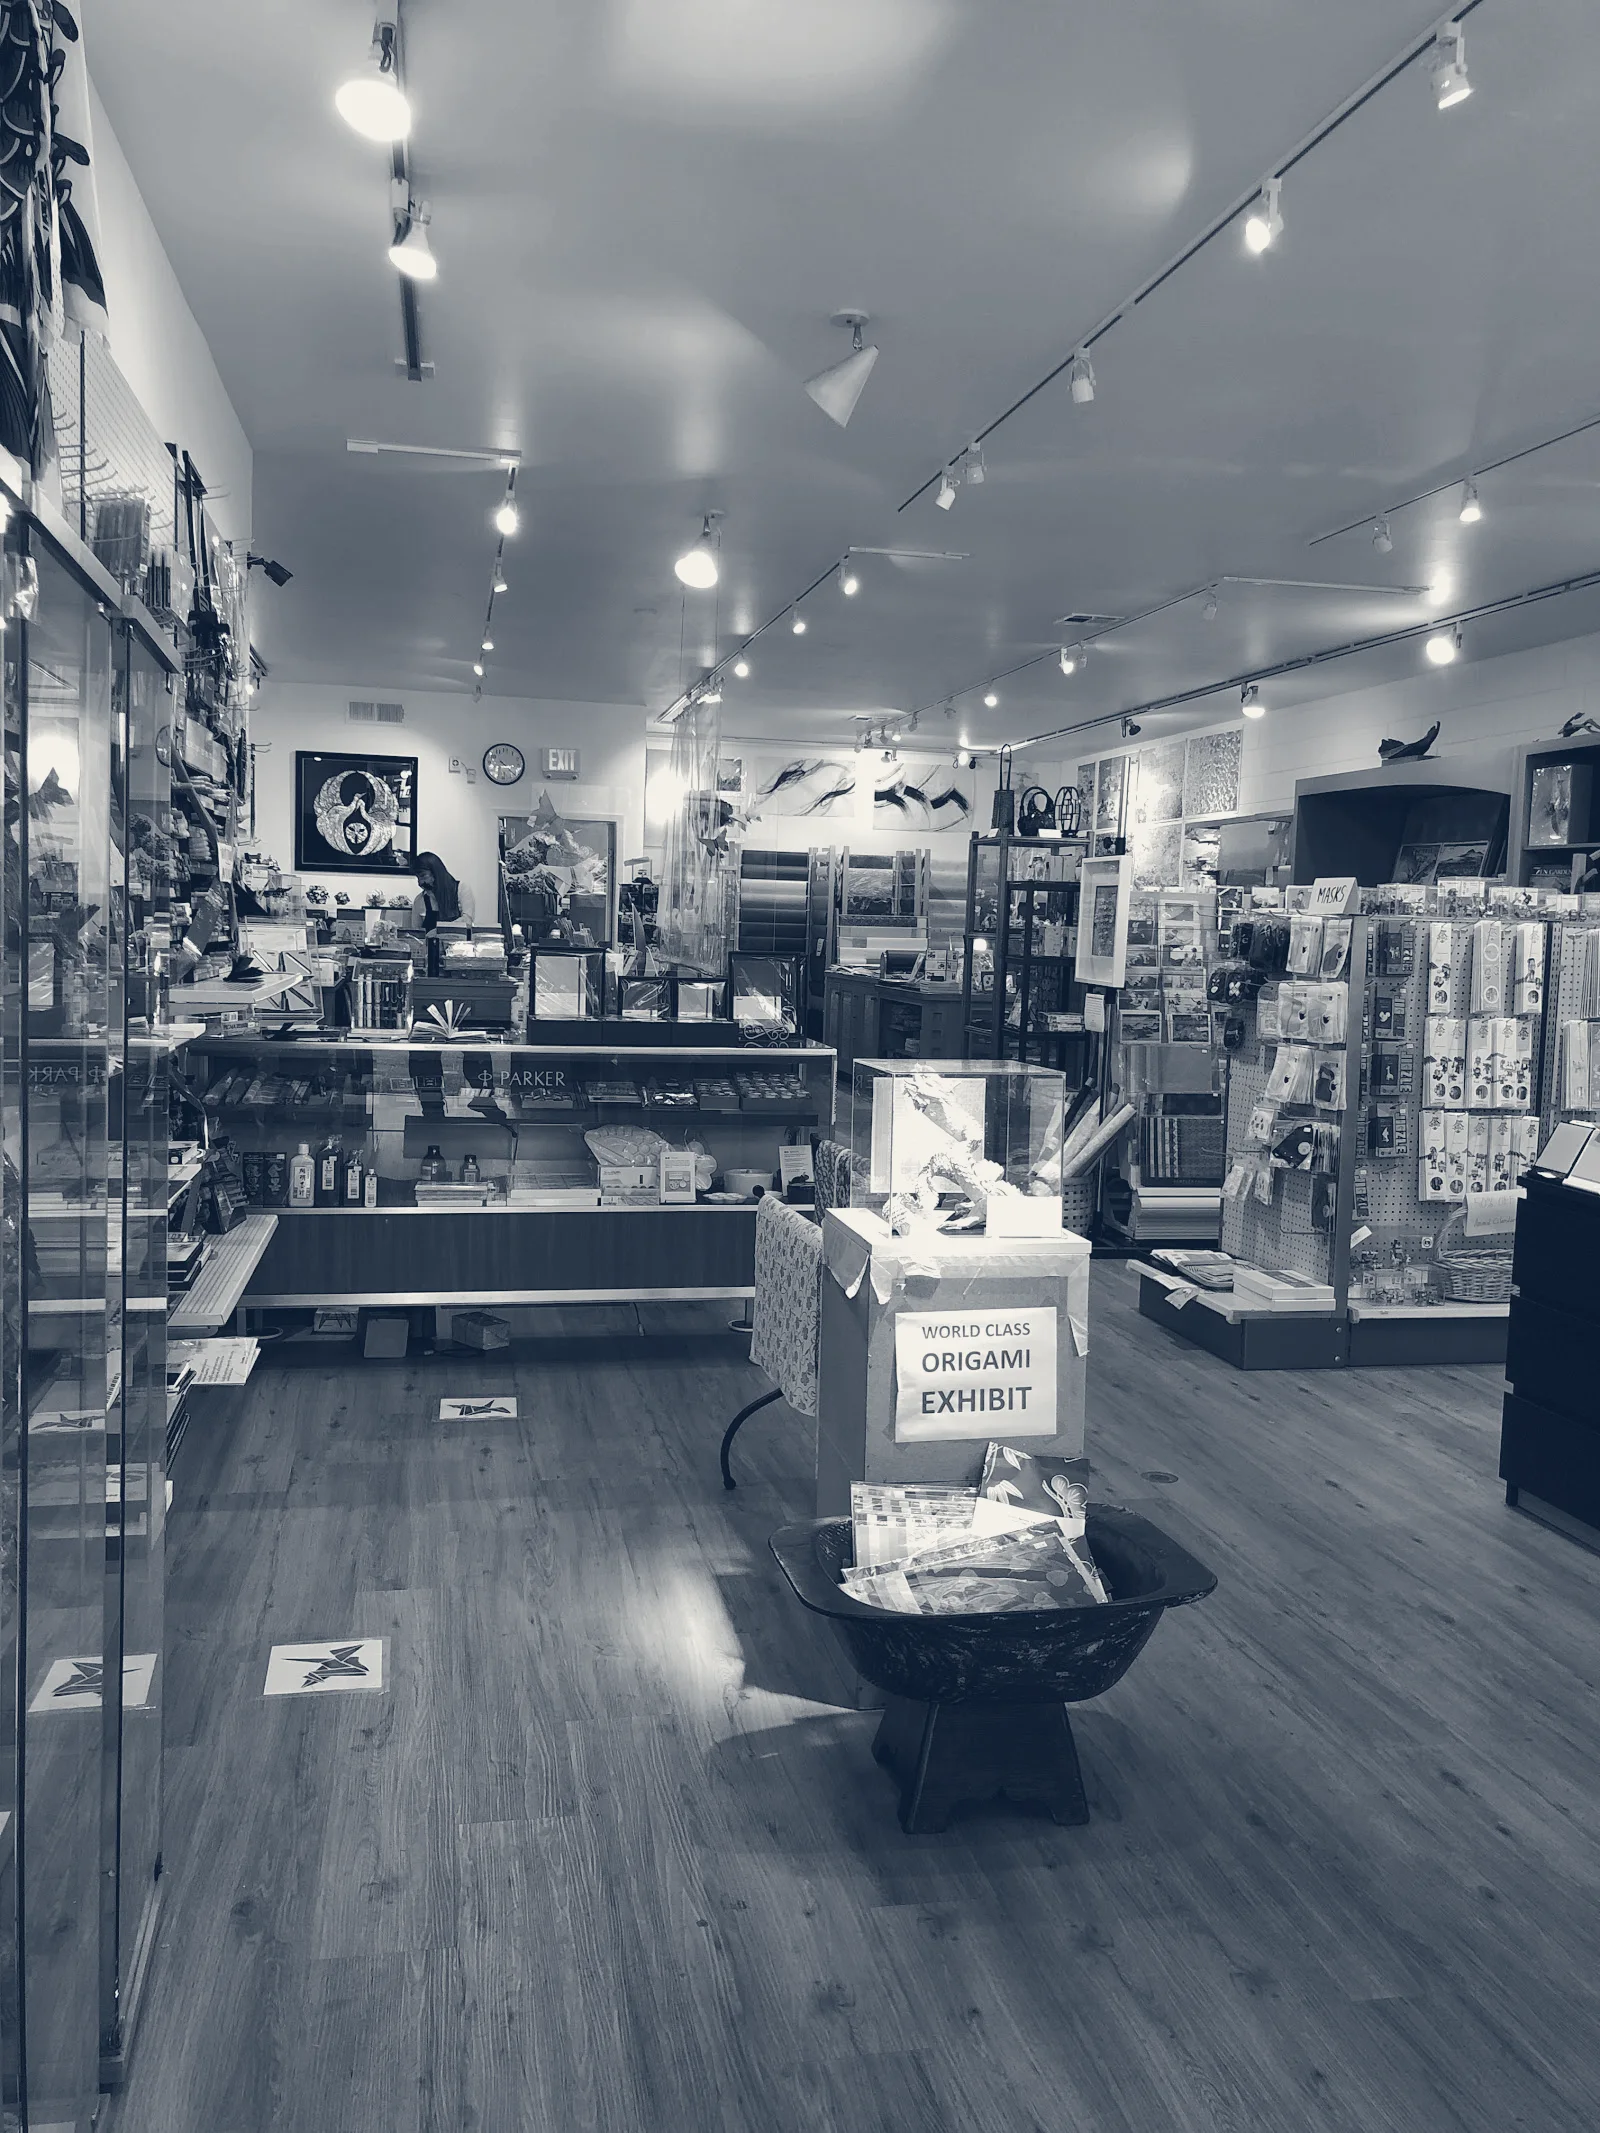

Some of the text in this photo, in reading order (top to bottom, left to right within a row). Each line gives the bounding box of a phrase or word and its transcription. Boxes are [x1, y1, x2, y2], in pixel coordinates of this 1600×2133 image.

[548, 748, 576, 771] EXIT
[1317, 885, 1347, 904] MASKS
[500, 1070, 566, 1087] PARKER
[922, 1322, 1031, 1339] WORLD CLASS
[921, 1349, 1030, 1373] ORIGAMI
[921, 1386, 1033, 1415] EXHIBIT
